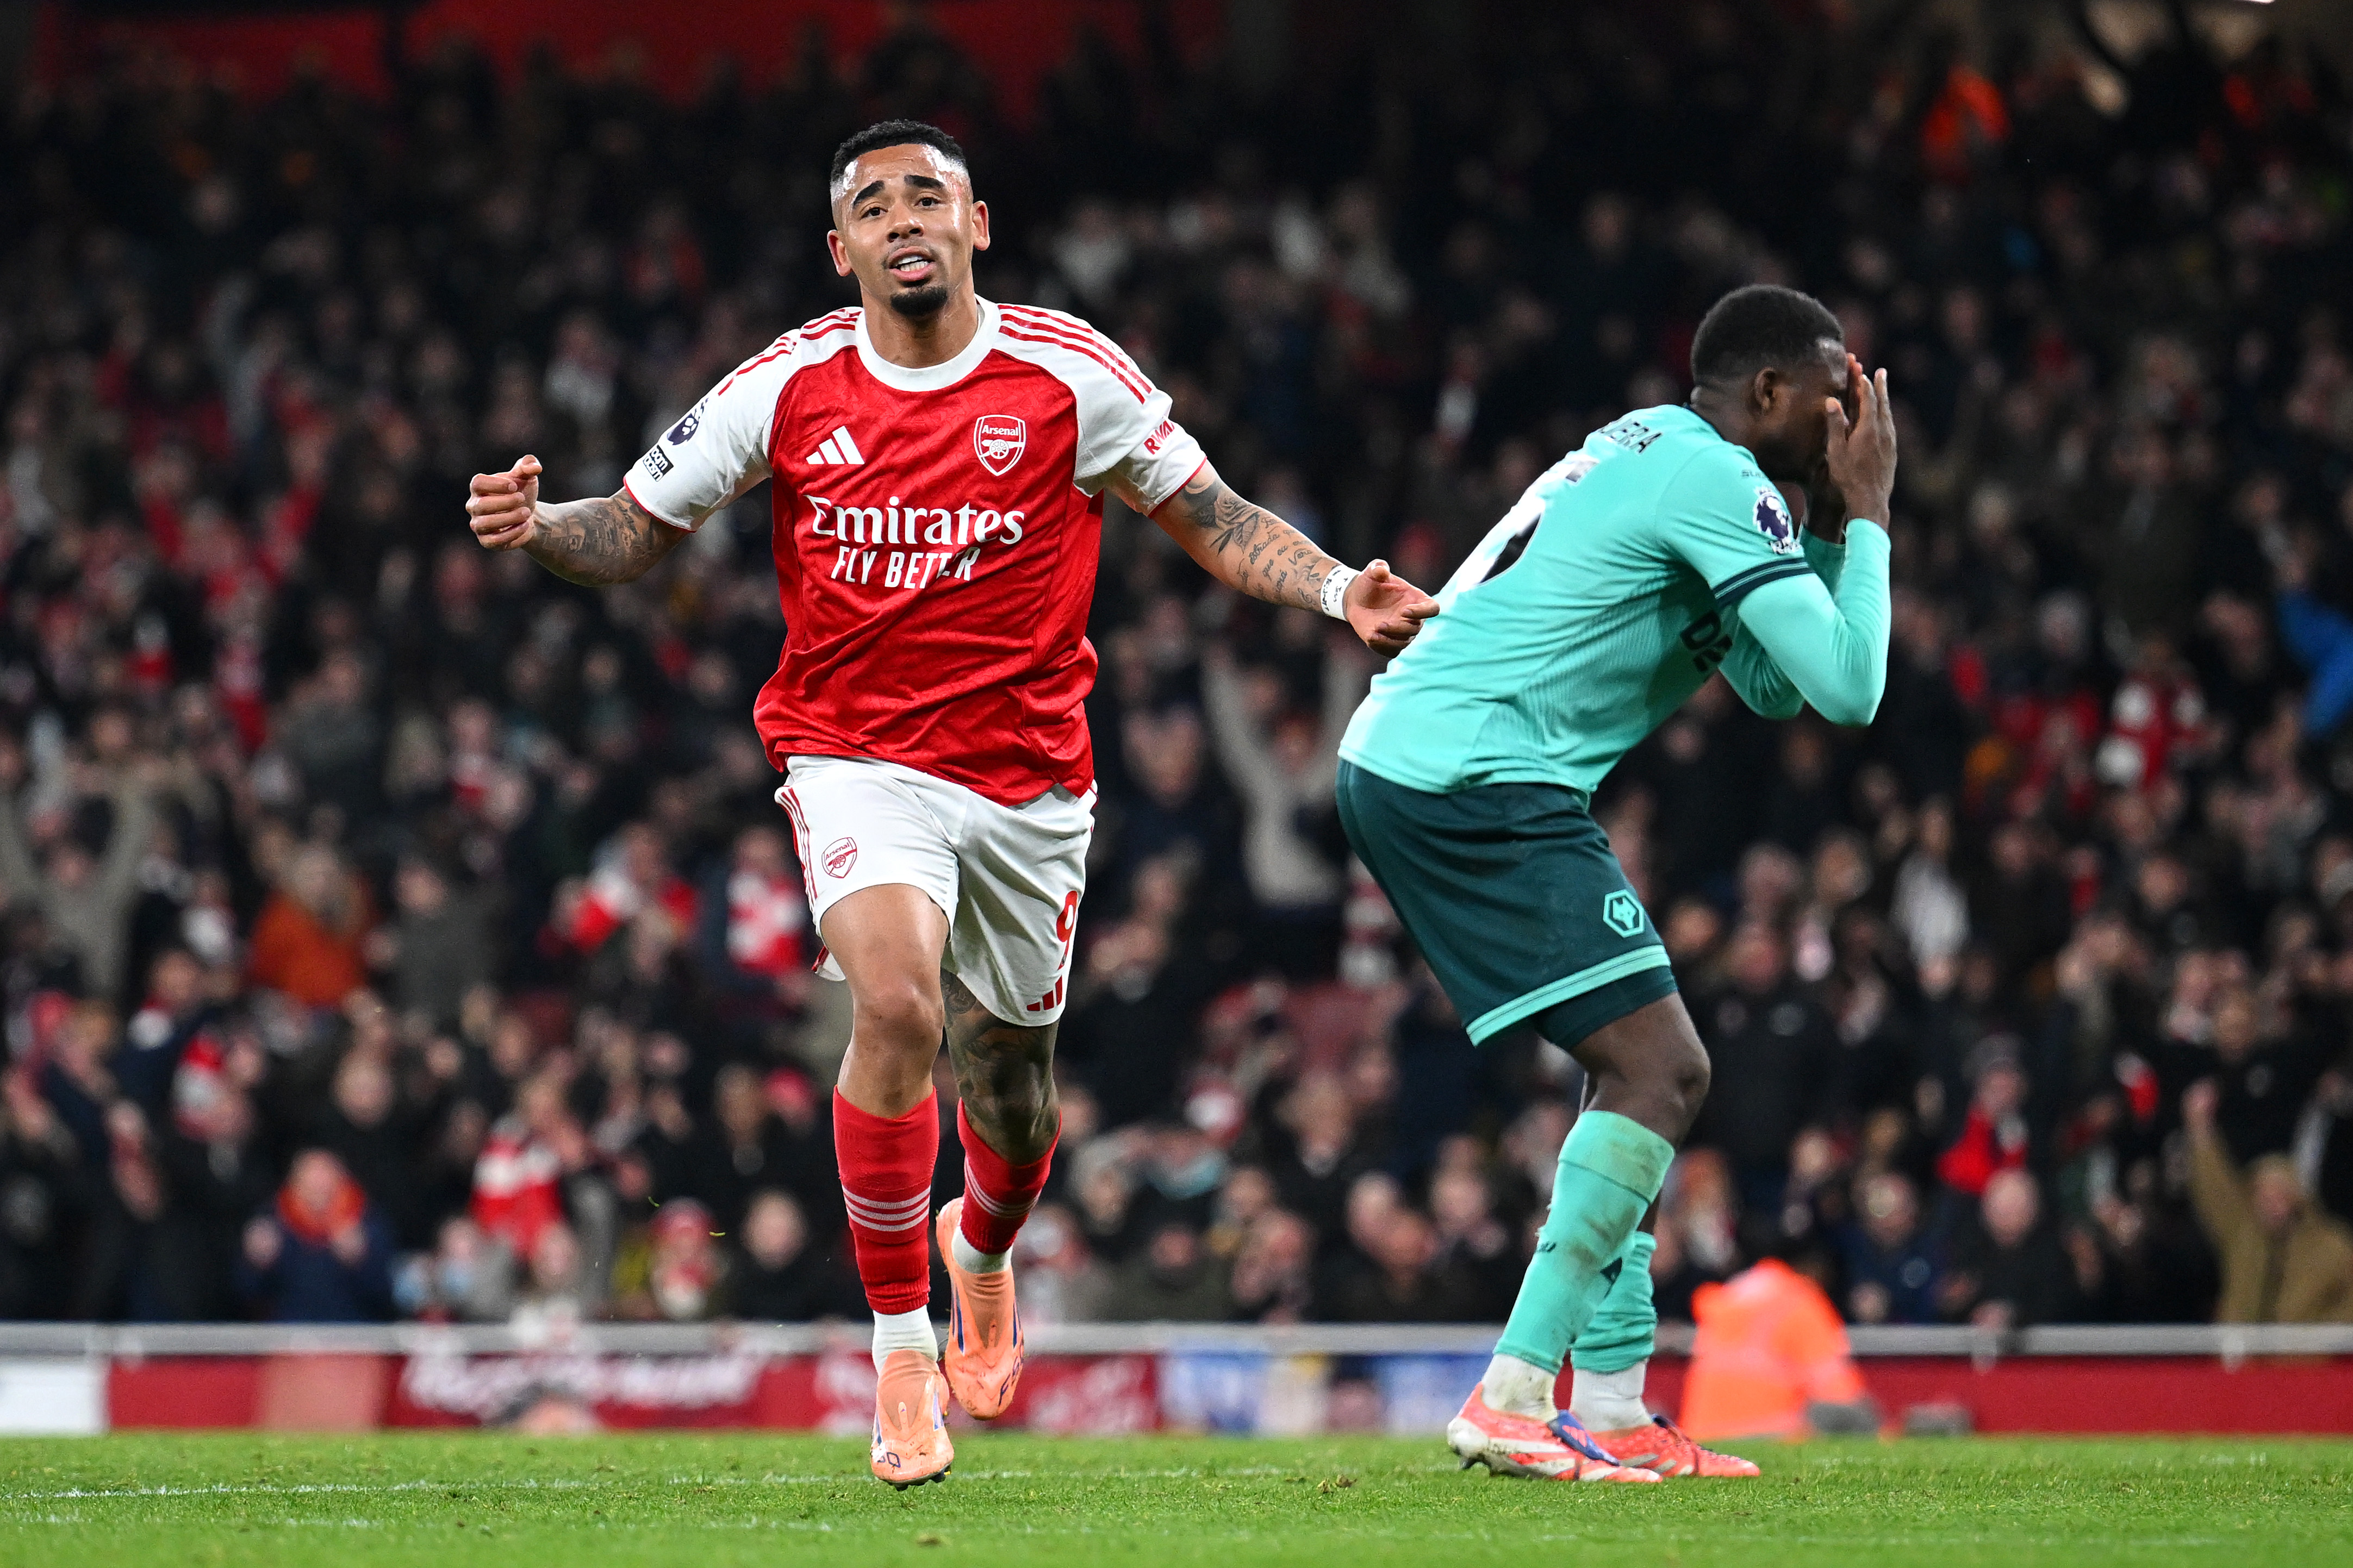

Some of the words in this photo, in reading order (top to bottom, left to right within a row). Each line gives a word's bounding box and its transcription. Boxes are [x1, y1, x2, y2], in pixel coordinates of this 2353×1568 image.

[981, 424, 1019, 436] Arsenal
[803, 495, 1025, 545] Emirates
[831, 545, 877, 584] FLY
[825, 842, 850, 860] Arsenal
[1056, 890, 1078, 971] 9
